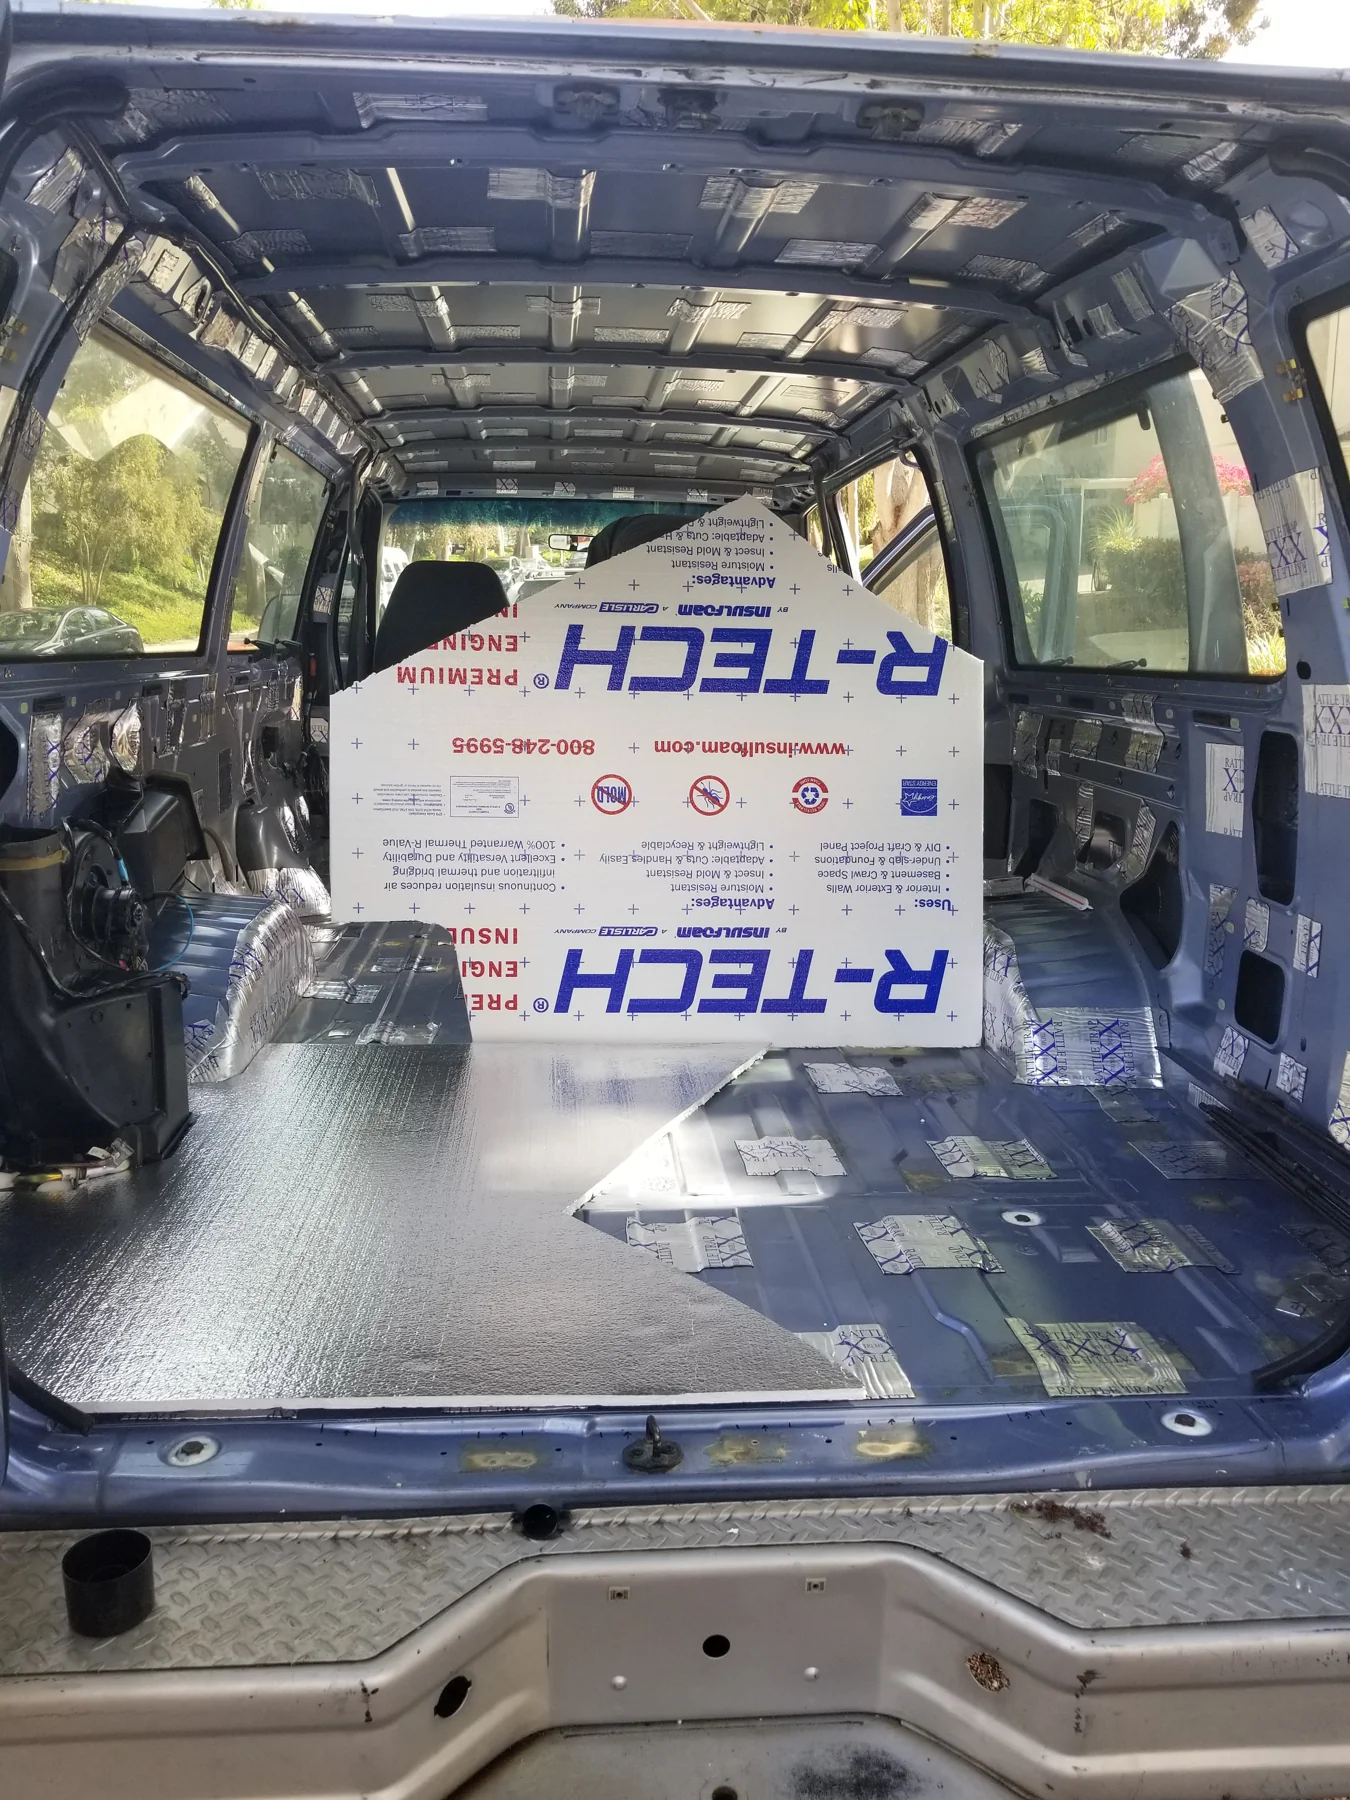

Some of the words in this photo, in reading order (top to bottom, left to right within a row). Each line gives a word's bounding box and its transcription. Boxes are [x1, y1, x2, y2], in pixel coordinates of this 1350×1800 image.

[697, 518, 705, 527] &
[708, 517, 764, 529] Lightweight
[676, 531, 684, 540] &
[686, 532, 709, 542] Cuts
[711, 531, 765, 543] Adaptable:
[646, 544, 693, 556] Resistant
[696, 546, 721, 556] Mold
[724, 547, 732, 556] &
[735, 547, 765, 557] Insect
[671, 559, 718, 570] Resistant
[721, 560, 765, 571] Moisture
[691, 574, 776, 588] Advantages:
[554, 602, 598, 610] COMPANY
[601, 602, 658, 613] CARLISLE
[554, 624, 948, 696] R-TECH
[397, 666, 518, 686] PREMIUM
[452, 737, 595, 756] 800-248-5995
[654, 741, 846, 758] www.insulfoam.com
[597, 786, 627, 803] MOLD
[382, 838, 422, 848] R-Value
[425, 839, 467, 849] Thermal
[470, 839, 524, 849] Warranted
[526, 840, 556, 849] 100%
[641, 840, 694, 850] Recyclable
[697, 841, 705, 850] &
[708, 840, 765, 850] Lightweight
[820, 842, 848, 852] Panel
[850, 840, 884, 852] Project
[887, 842, 912, 852] Craft
[914, 842, 922, 851] &
[924, 842, 941, 852] DIY
[382, 852, 432, 863] Durability
[435, 854, 455, 863] and
[458, 852, 508, 863] Versatility
[510, 854, 556, 863] Excellent
[599, 854, 628, 864] Easily
[631, 855, 672, 864] Handles
[675, 855, 683, 864] &
[686, 855, 709, 864] Cuts
[711, 854, 765, 865] Adaptable:
[814, 856, 875, 866] Foundations
[877, 856, 886, 866] &
[888, 856, 941, 866] Under-slab
[392, 866, 435, 877] bridging
[438, 868, 478, 878] thermal
[481, 868, 500, 878] and
[503, 868, 555, 878] infiltration
[646, 869, 693, 879] Resistant
[696, 869, 721, 879] Mold
[723, 870, 732, 879] &
[734, 869, 765, 879] Insect
[817, 868, 848, 879] Space
[850, 870, 878, 880] Crawl
[880, 870, 888, 879] &
[890, 870, 941, 880] Basement
[384, 882, 398, 892] air
[400, 882, 442, 892] reduces
[445, 882, 495, 892] insulation
[498, 882, 556, 892] Continuous
[670, 884, 718, 893] Resistant
[720, 884, 764, 893] Moisture
[826, 884, 853, 894] Walls
[855, 884, 892, 894] Exterior
[895, 884, 903, 893] &
[906, 884, 941, 894] Interior
[691, 896, 775, 910] Advantages:
[914, 899, 951, 911] Uses:
[599, 926, 658, 937] CARLISLE
[553, 949, 950, 1014] R-TECH
[1057, 1386, 1121, 1395] RATTLE
[1122, 1384, 1165, 1394] TRAP
